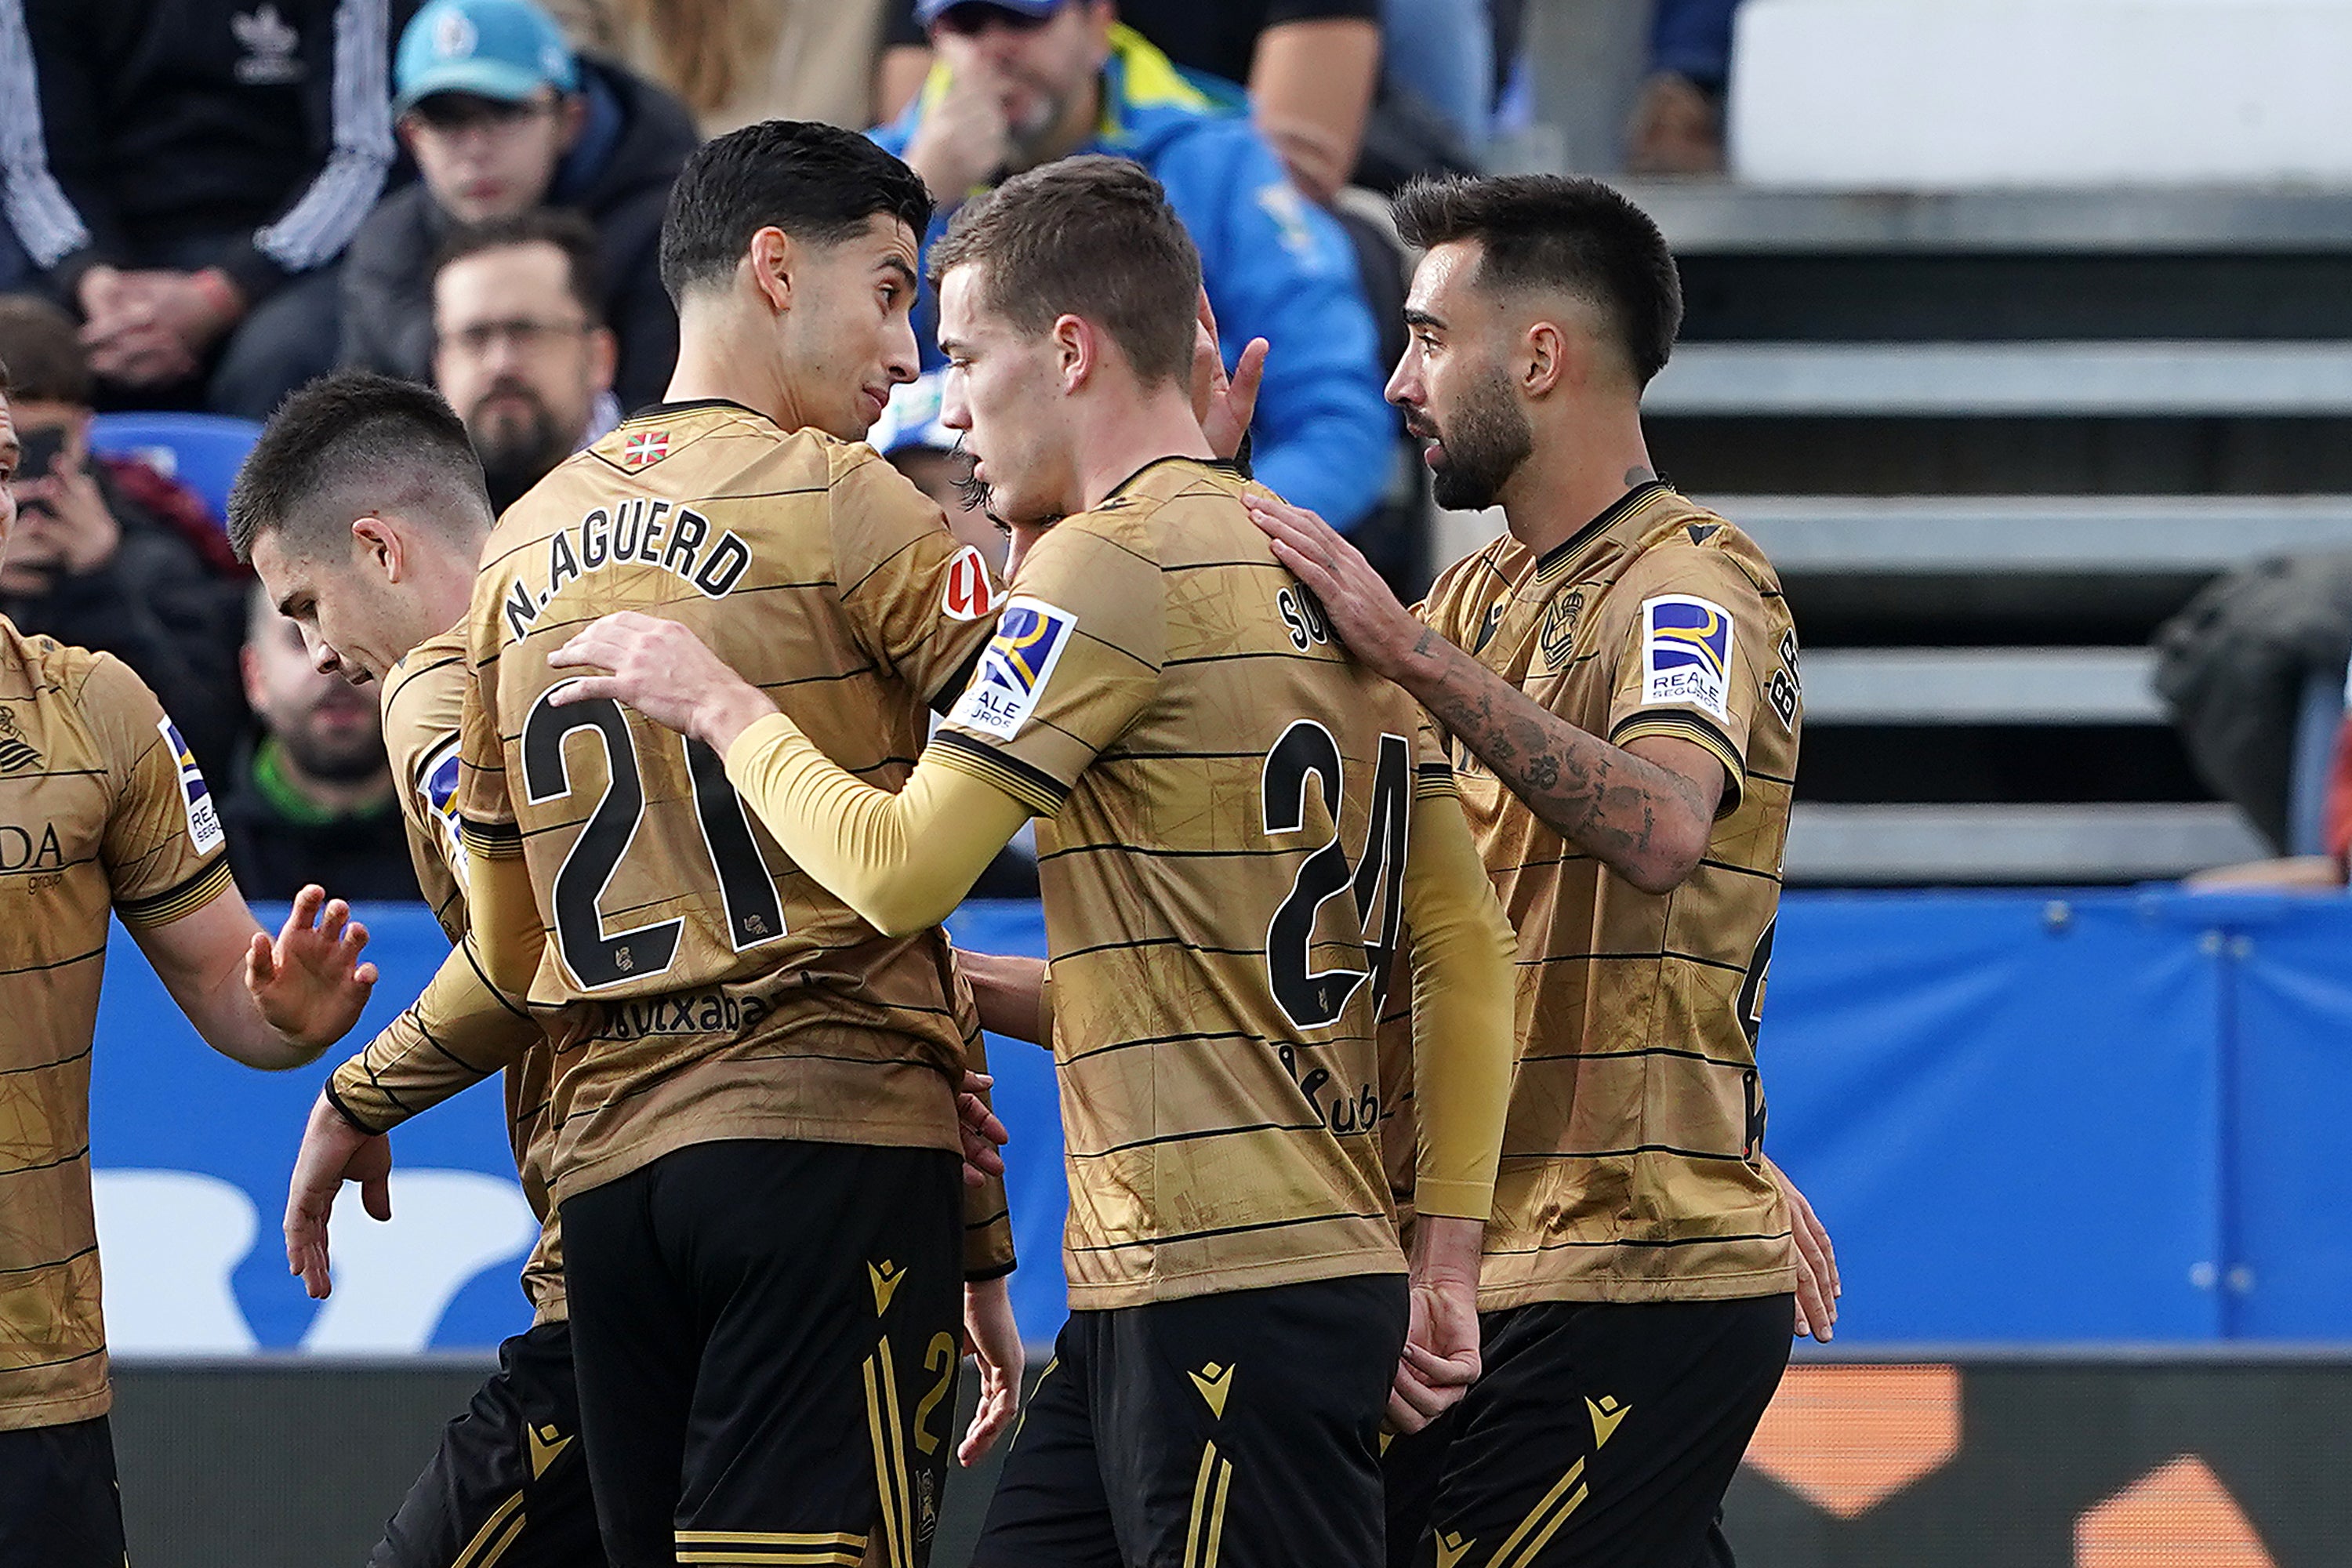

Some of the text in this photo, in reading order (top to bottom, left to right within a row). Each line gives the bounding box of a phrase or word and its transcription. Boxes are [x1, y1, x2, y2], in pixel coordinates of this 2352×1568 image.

[1276, 582, 1344, 653] SU
[1653, 671, 1720, 703] REALE
[1653, 687, 1721, 713] SEGUROS
[0, 822, 64, 871] DA
[521, 676, 788, 992] 21
[1262, 719, 1410, 1031] 24
